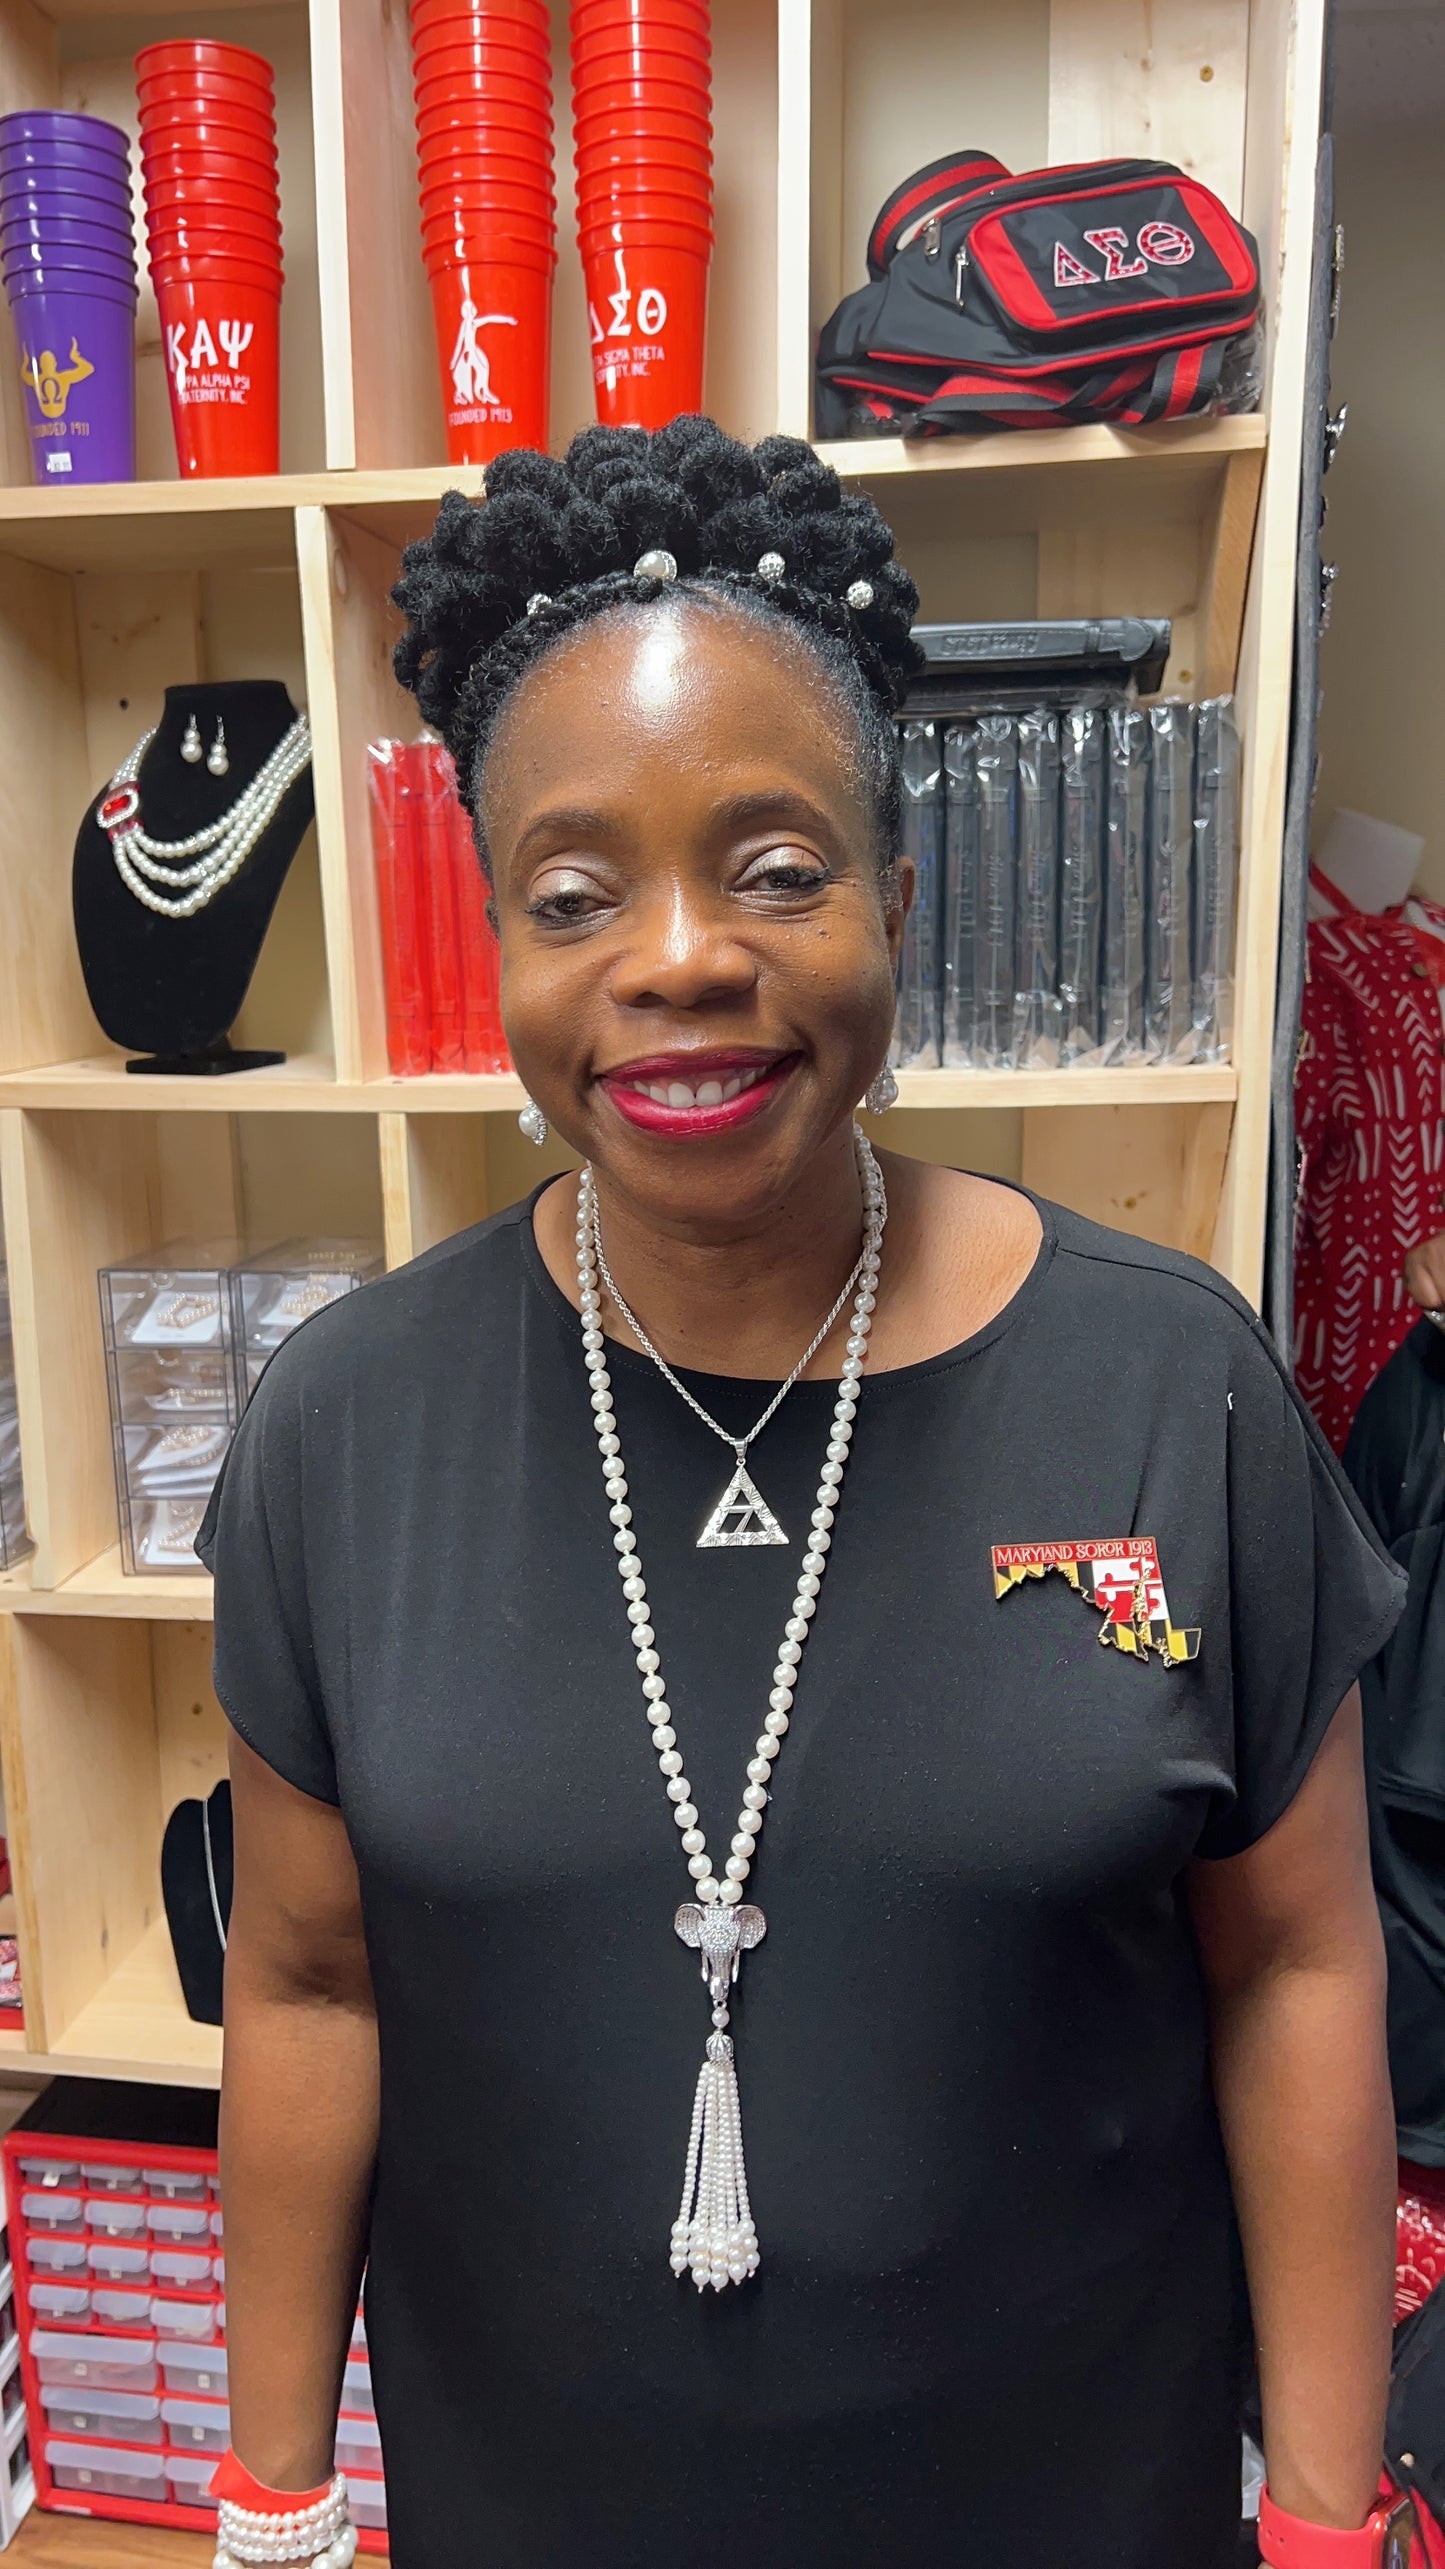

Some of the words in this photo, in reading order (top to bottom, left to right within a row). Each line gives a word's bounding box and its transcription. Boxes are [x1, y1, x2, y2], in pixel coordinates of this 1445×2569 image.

[1053, 221, 1195, 288] ΔΣΘ
[632, 346, 665, 361] THETA
[200, 373, 233, 388] ALPHA
[233, 373, 250, 391] PSI
[490, 408, 513, 424] 1913
[70, 421, 90, 437] 1911
[997, 1545, 1074, 1564] MARYLAND
[1075, 1541, 1125, 1560] SOROR
[1127, 1540, 1153, 1556] 1913
